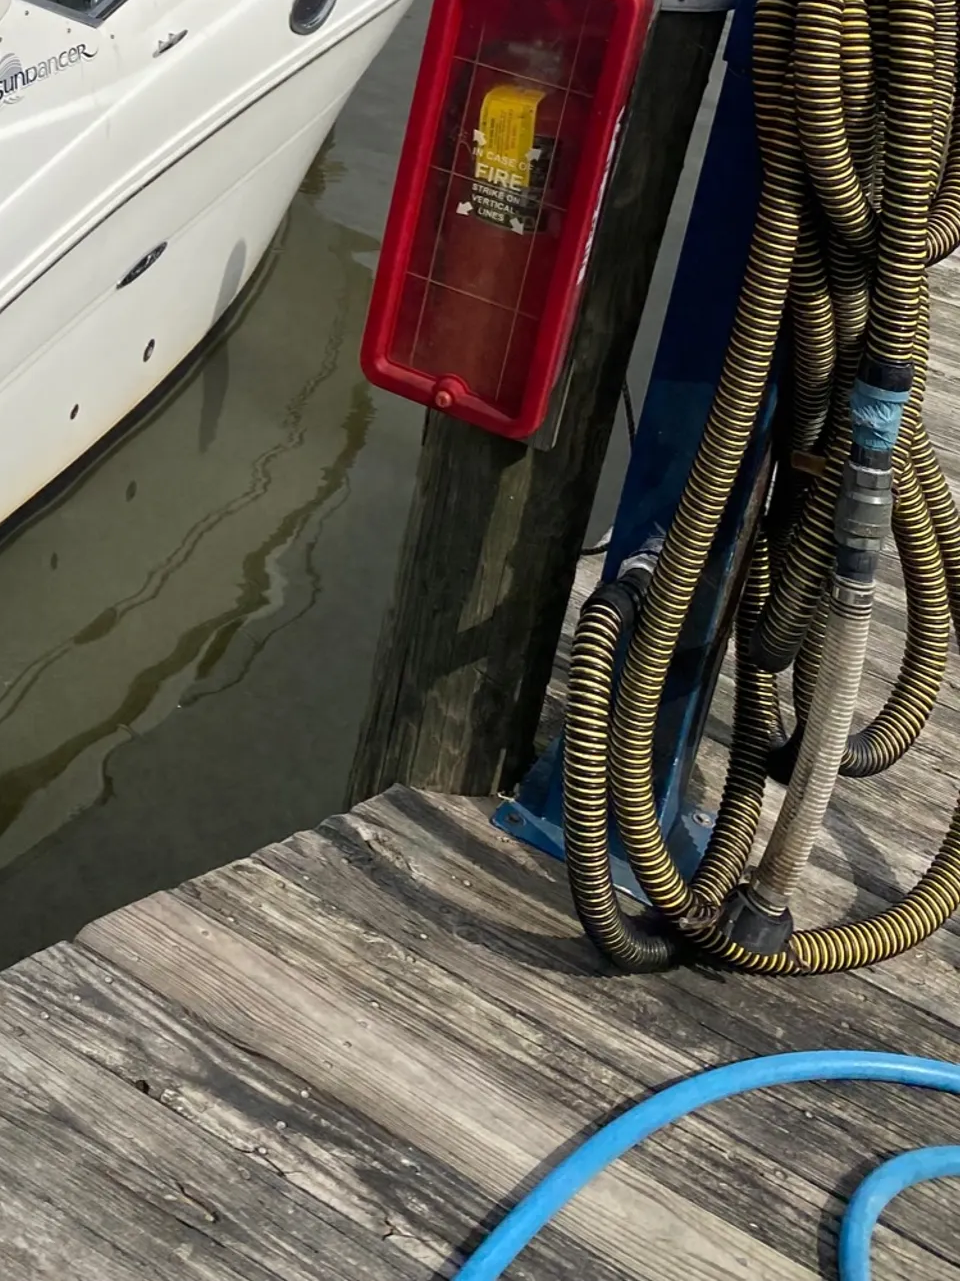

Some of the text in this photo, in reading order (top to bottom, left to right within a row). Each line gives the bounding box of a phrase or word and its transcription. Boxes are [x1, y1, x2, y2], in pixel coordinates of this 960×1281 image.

[472, 147, 484, 157] IN
[486, 151, 517, 168] CASE
[475, 162, 524, 192] FIRE
[472, 183, 520, 205] STRIKE ON
[472, 194, 516, 214] VERTICAL
[478, 206, 505, 222] LINES
